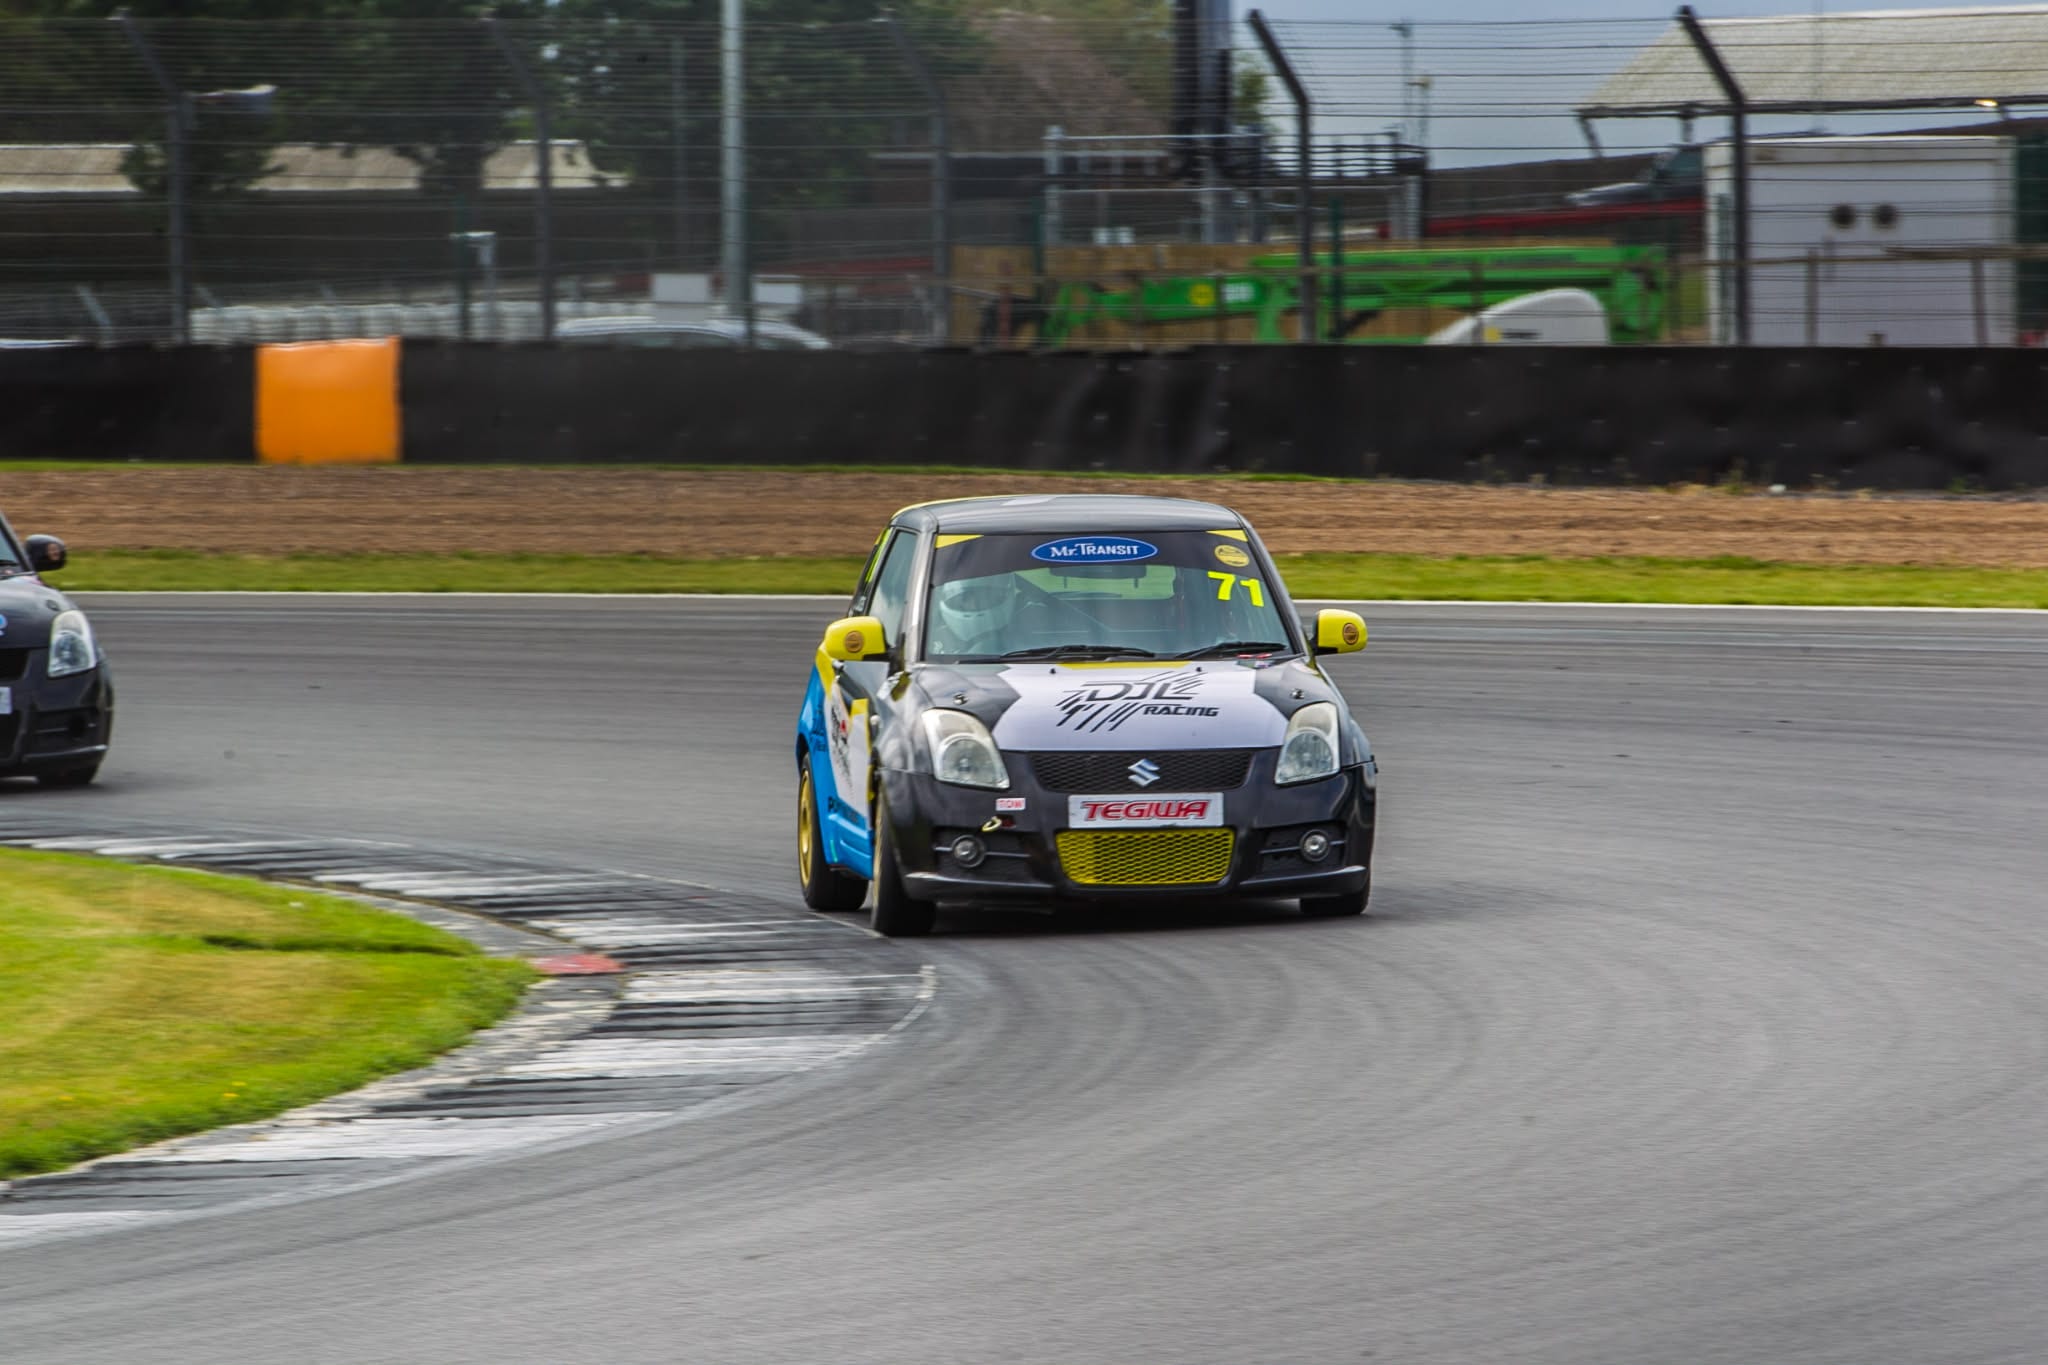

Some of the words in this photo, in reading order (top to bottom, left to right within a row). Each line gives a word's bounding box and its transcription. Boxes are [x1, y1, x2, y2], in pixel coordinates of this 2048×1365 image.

[1207, 570, 1265, 607] 71
[1081, 681, 1194, 702] DJL
[1143, 706, 1221, 718] RACING
[1081, 800, 1211, 821] TEGIWA
